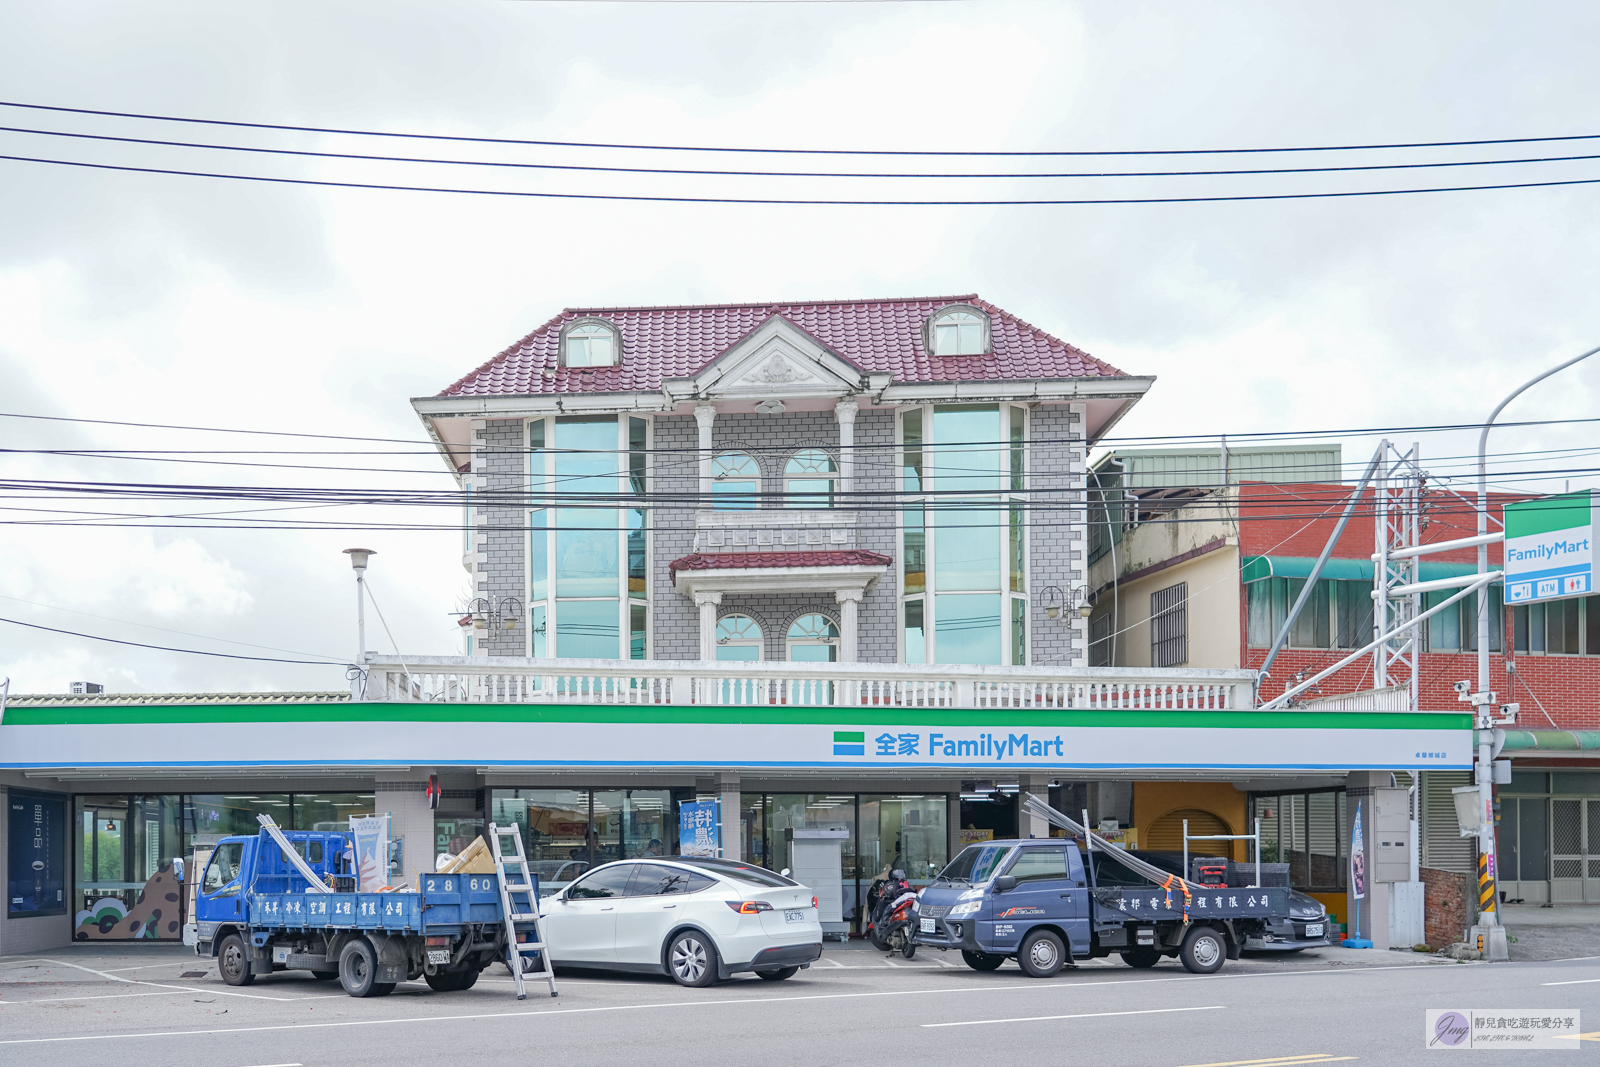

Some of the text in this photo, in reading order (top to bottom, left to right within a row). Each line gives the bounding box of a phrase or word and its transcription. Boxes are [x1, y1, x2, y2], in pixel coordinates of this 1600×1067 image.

[1508, 539, 1588, 562] FamilyMart
[1541, 583, 1555, 593] ATM
[875, 733, 1063, 760] 全家 FamilyMart
